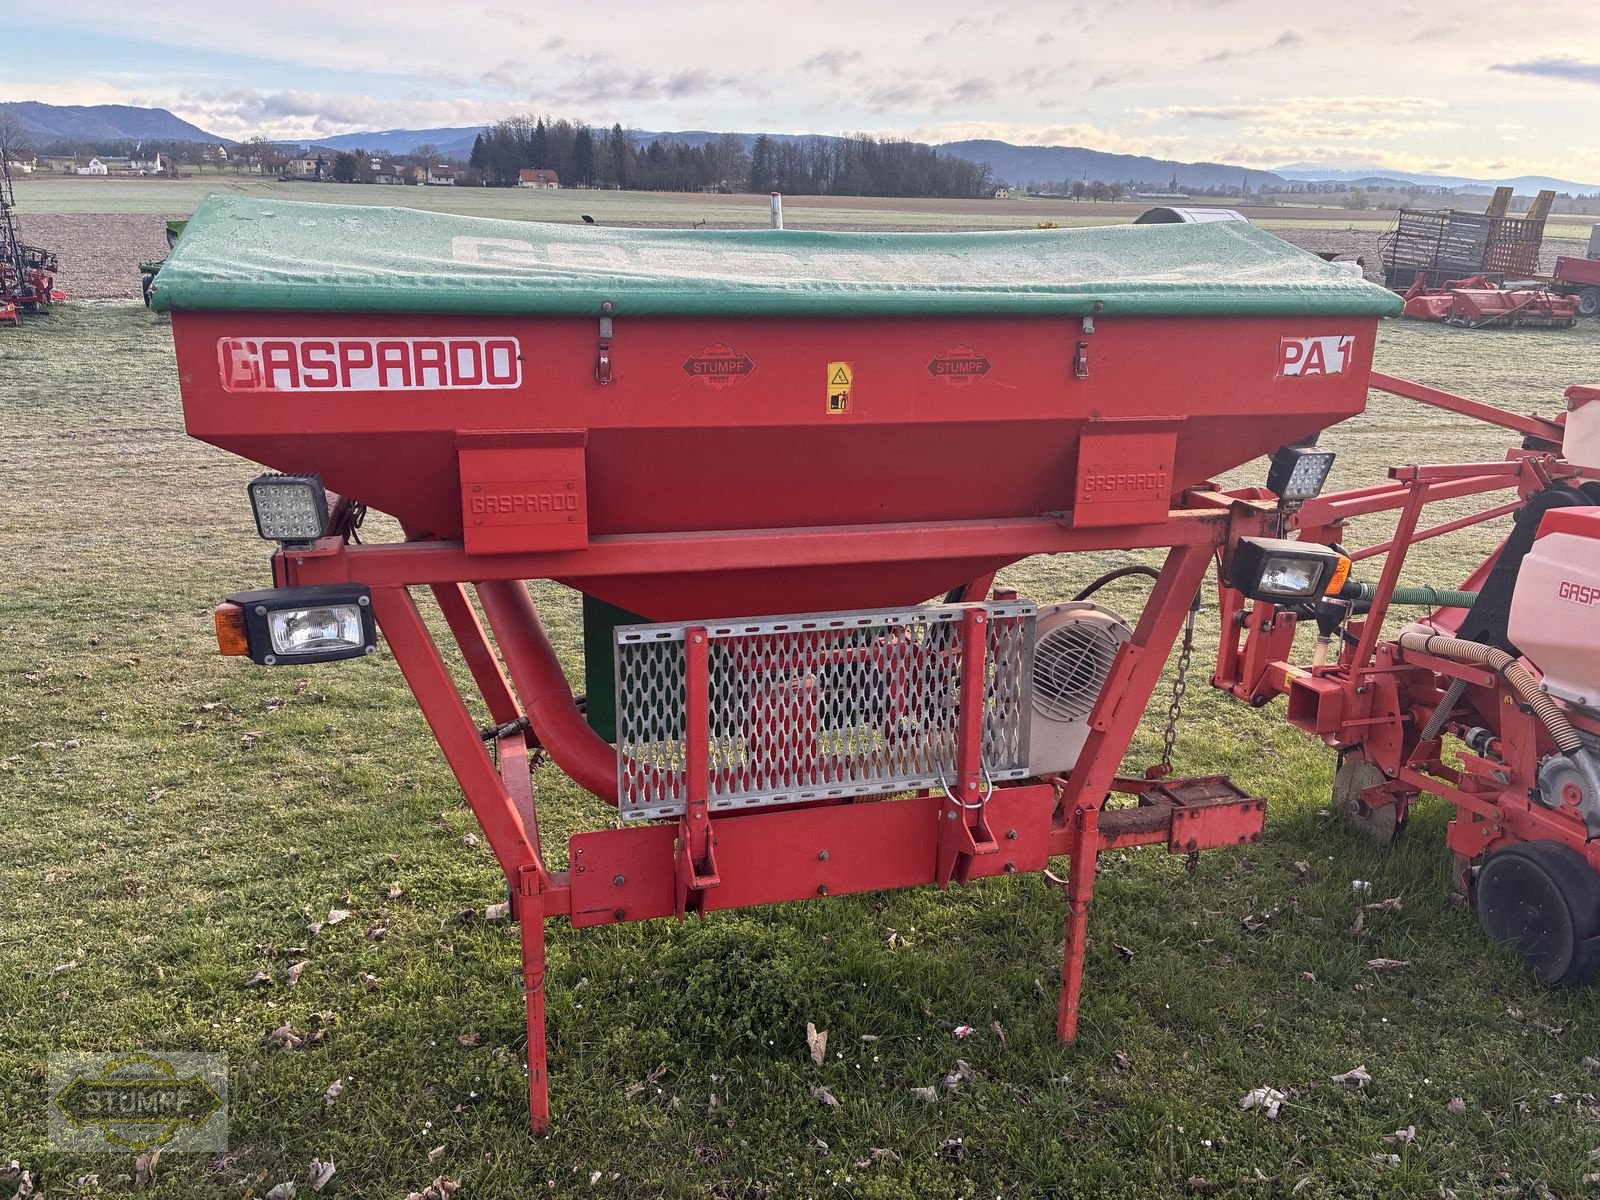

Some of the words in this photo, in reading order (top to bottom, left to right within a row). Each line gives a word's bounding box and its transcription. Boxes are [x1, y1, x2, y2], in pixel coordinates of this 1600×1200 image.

[222, 340, 518, 389] GASPARDO
[693, 361, 744, 373] STUMPF
[936, 361, 983, 374] STUMPF
[1280, 340, 1327, 376] PA
[1084, 473, 1167, 492] GASPARDO
[471, 493, 578, 514] GASPARDO
